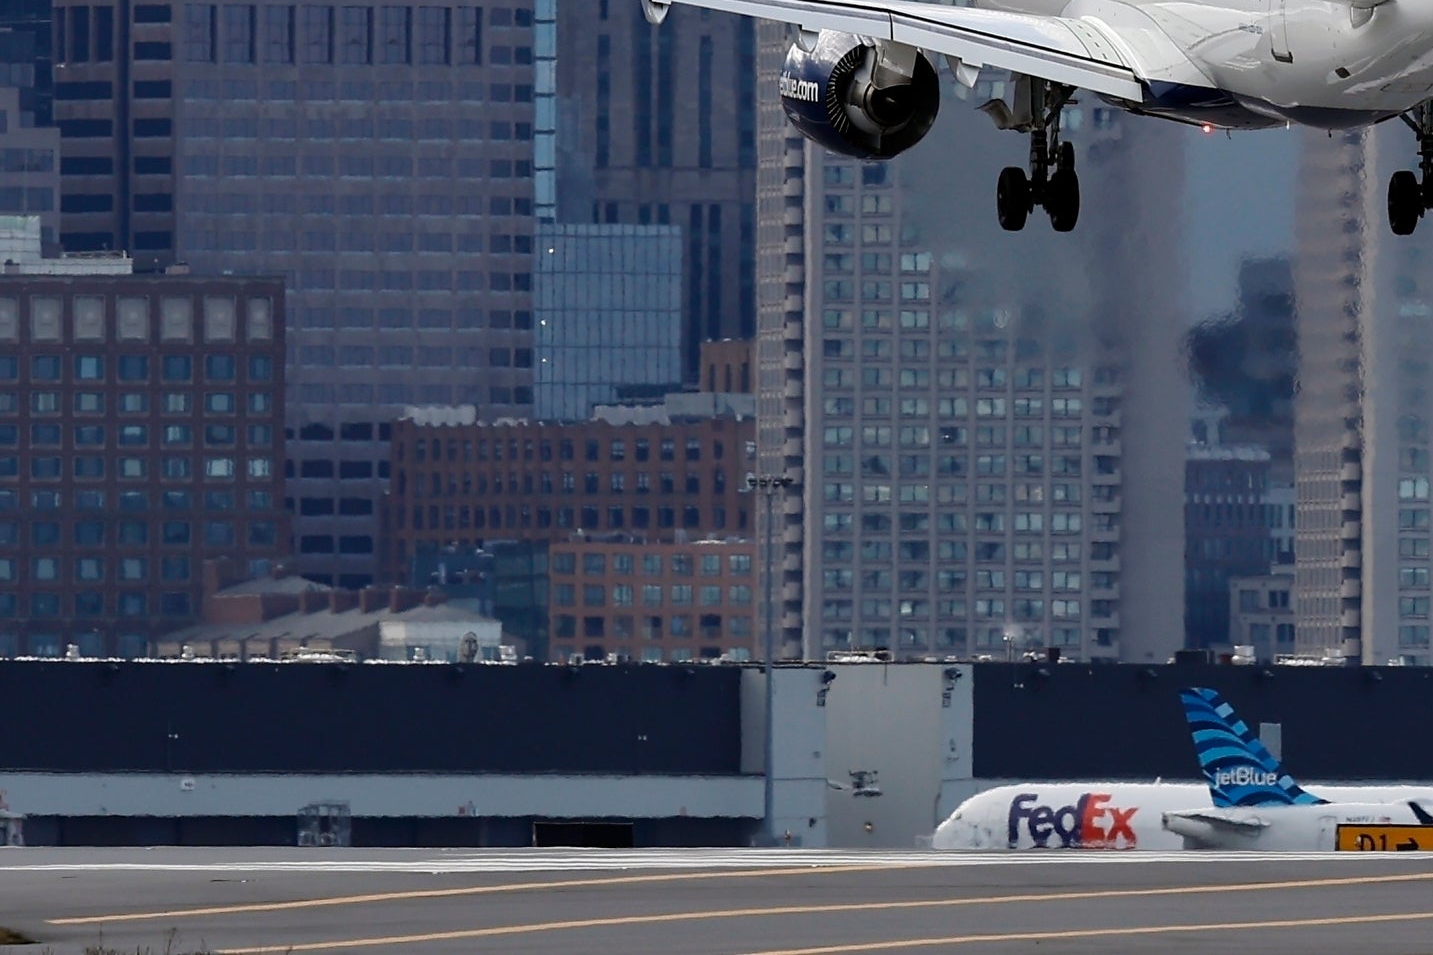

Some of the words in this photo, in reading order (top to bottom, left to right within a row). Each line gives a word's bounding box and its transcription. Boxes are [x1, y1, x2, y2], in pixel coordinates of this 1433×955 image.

[1214, 767, 1277, 789] jetBlue
[1008, 793, 1139, 848] FedEx
[1358, 833, 1387, 851] D1
